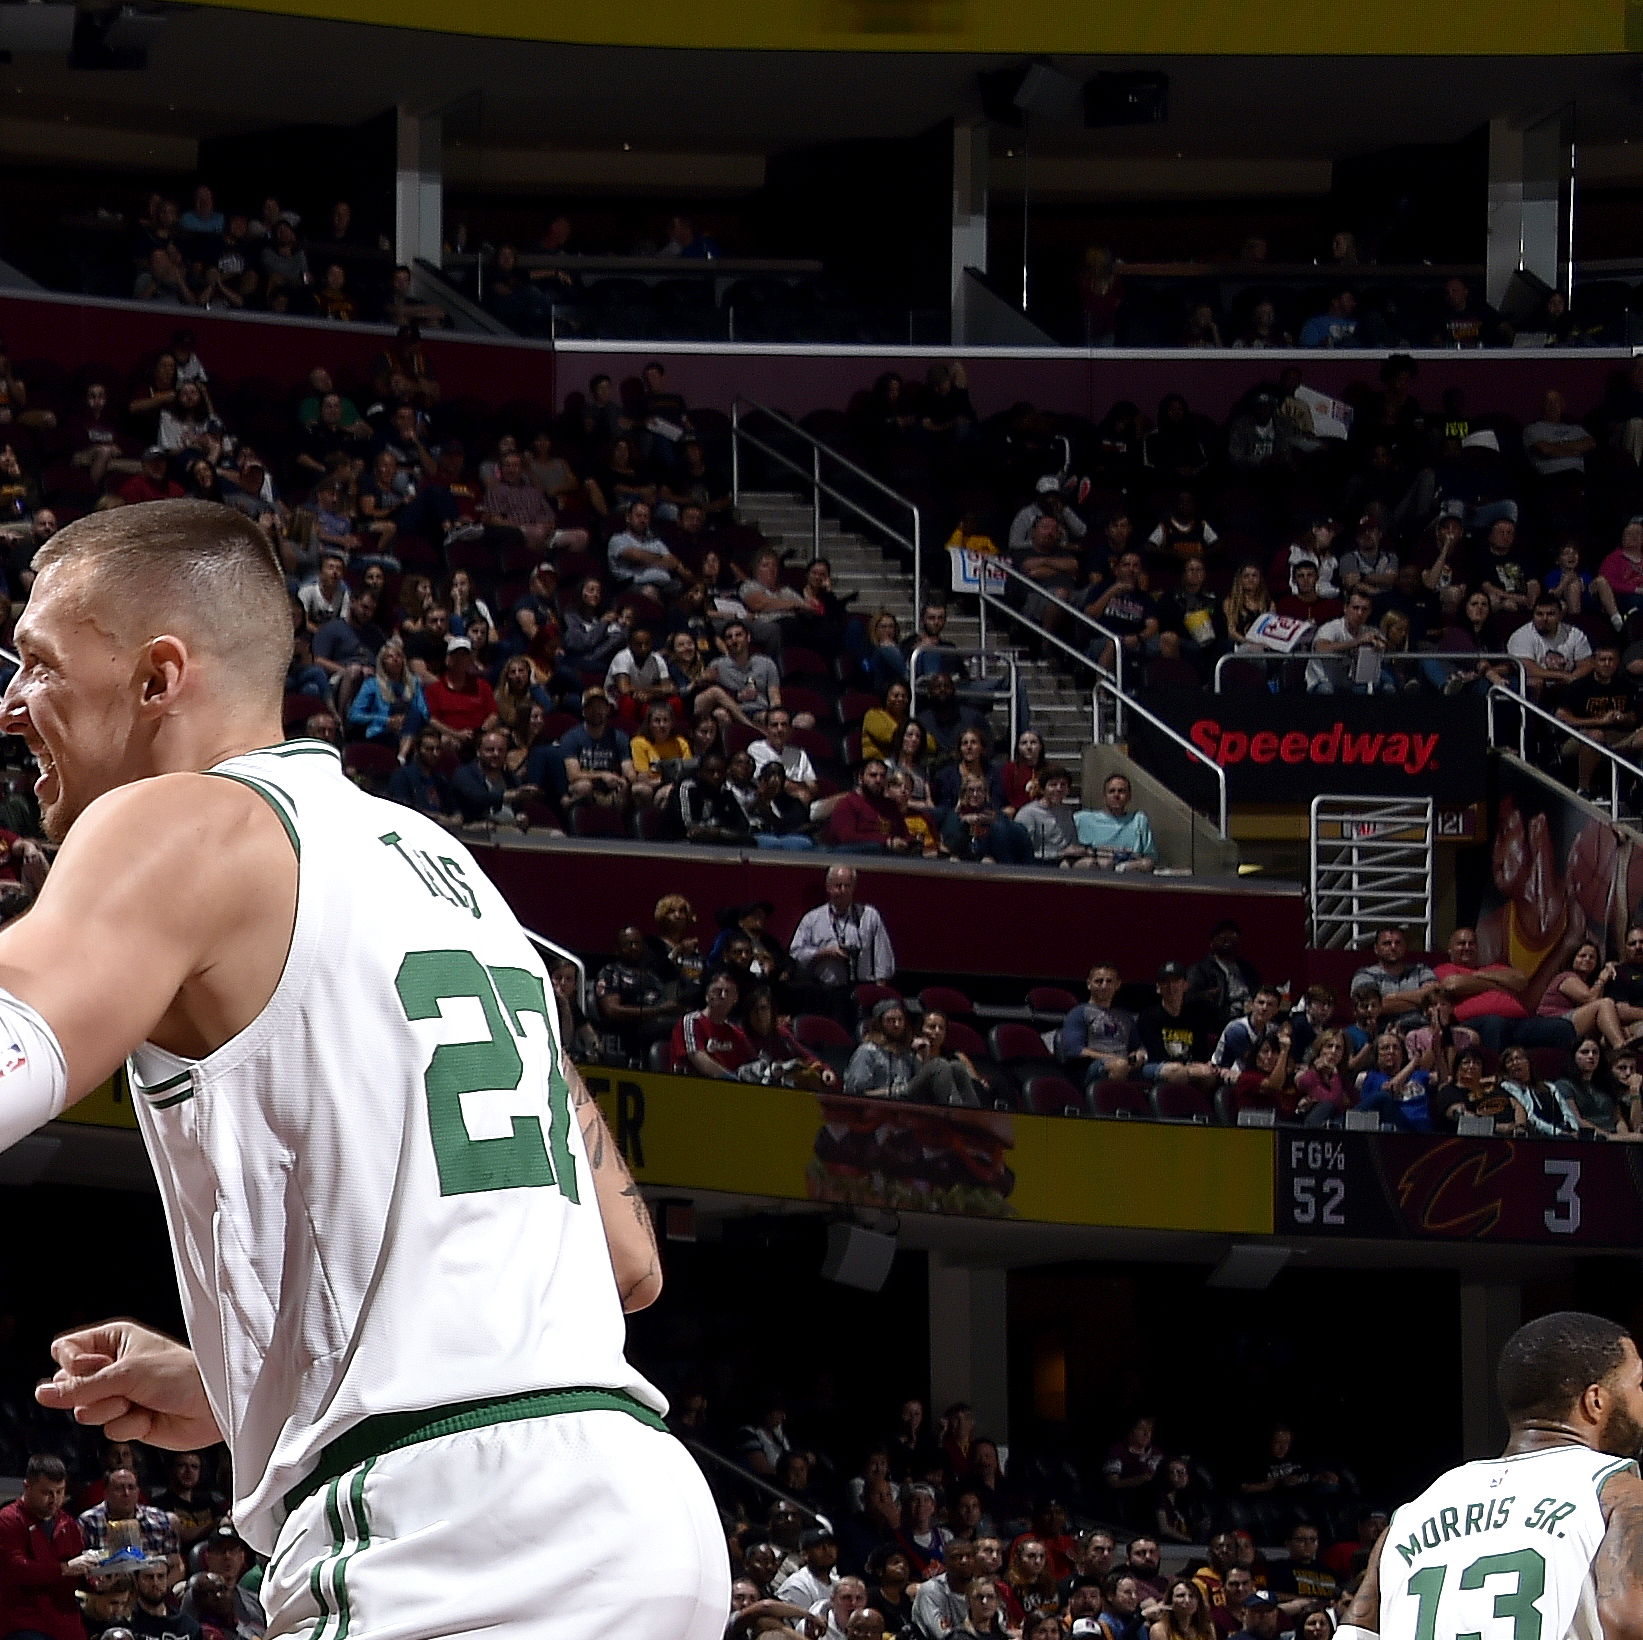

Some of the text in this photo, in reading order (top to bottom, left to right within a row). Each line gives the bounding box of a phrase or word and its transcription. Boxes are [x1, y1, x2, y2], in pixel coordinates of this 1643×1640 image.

[1185, 717, 1440, 776] Speedway
[1290, 1139, 1346, 1172] FG%
[1292, 1175, 1346, 1226] 52
[1543, 1157, 1583, 1236] 3
[1393, 1494, 1578, 1569] MORRIS SR.
